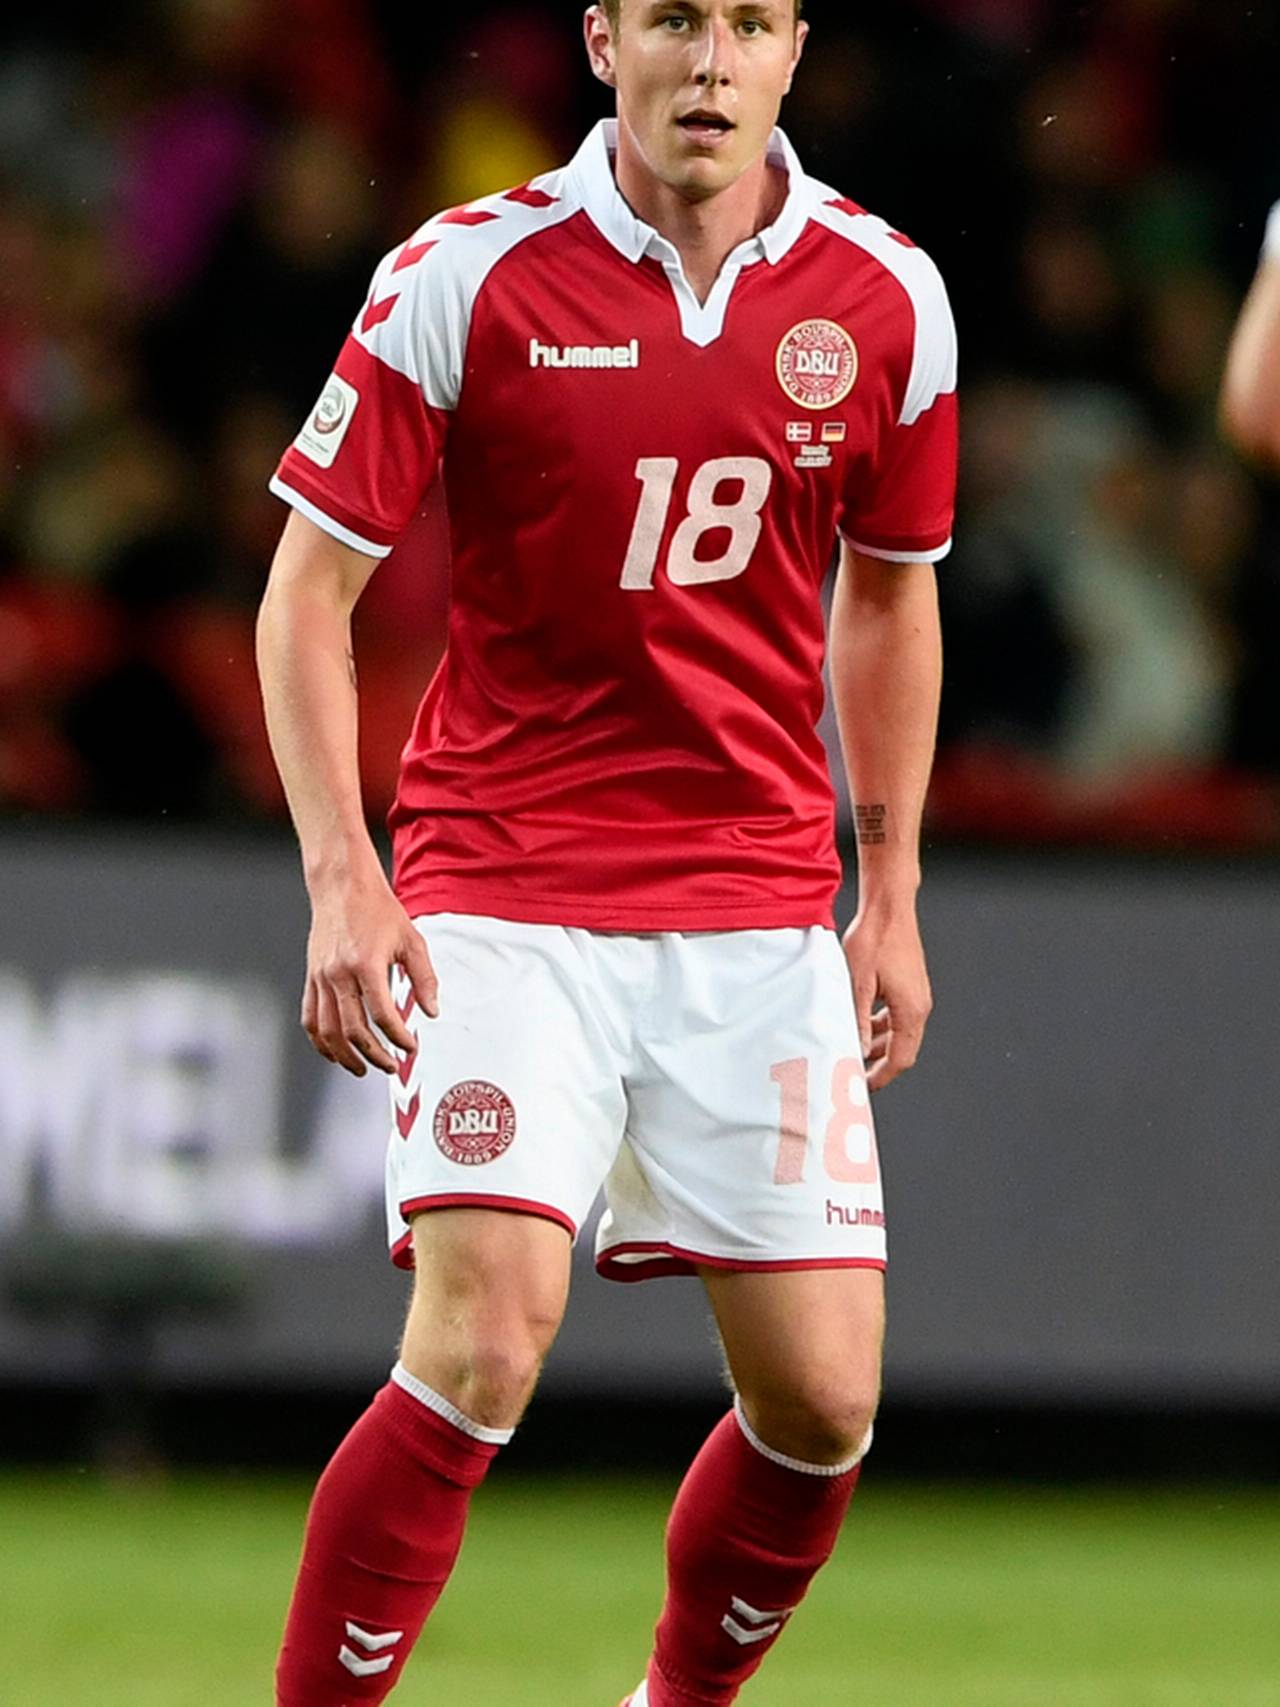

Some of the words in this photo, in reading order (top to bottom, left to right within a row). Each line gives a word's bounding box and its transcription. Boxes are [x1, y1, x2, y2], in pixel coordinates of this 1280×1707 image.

[529, 337, 639, 369] hummel
[794, 349, 840, 376] DBU
[619, 457, 773, 590] 18
[448, 1108, 499, 1136] DBU
[769, 1056, 878, 1185] 18
